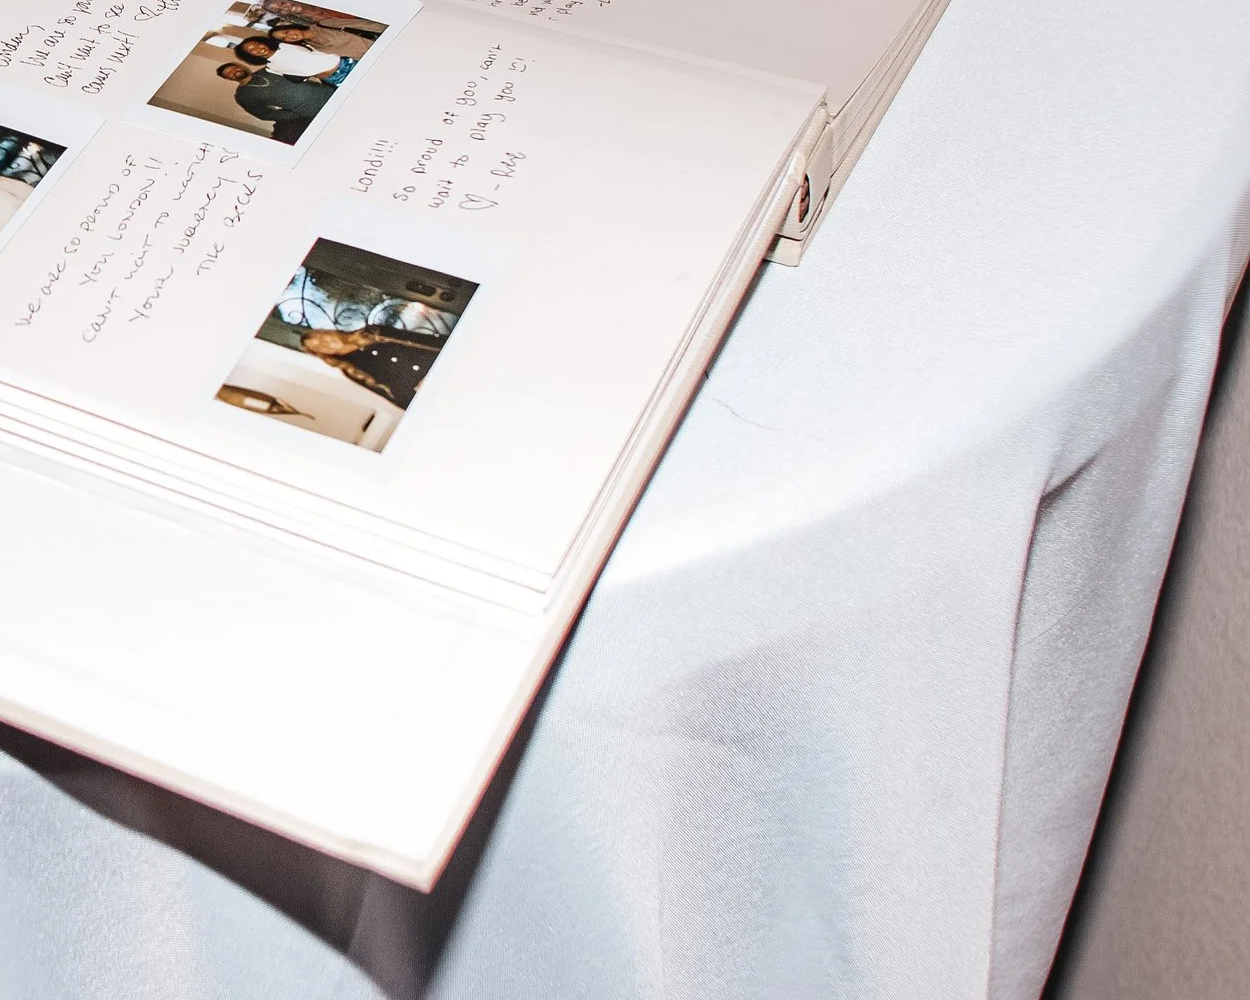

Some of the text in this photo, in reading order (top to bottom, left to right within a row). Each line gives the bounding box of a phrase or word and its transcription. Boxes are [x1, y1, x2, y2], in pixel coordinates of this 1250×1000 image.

[411, 138, 444, 174] proud
[442, 111, 459, 125] of
[428, 81, 516, 209] wait to play you
